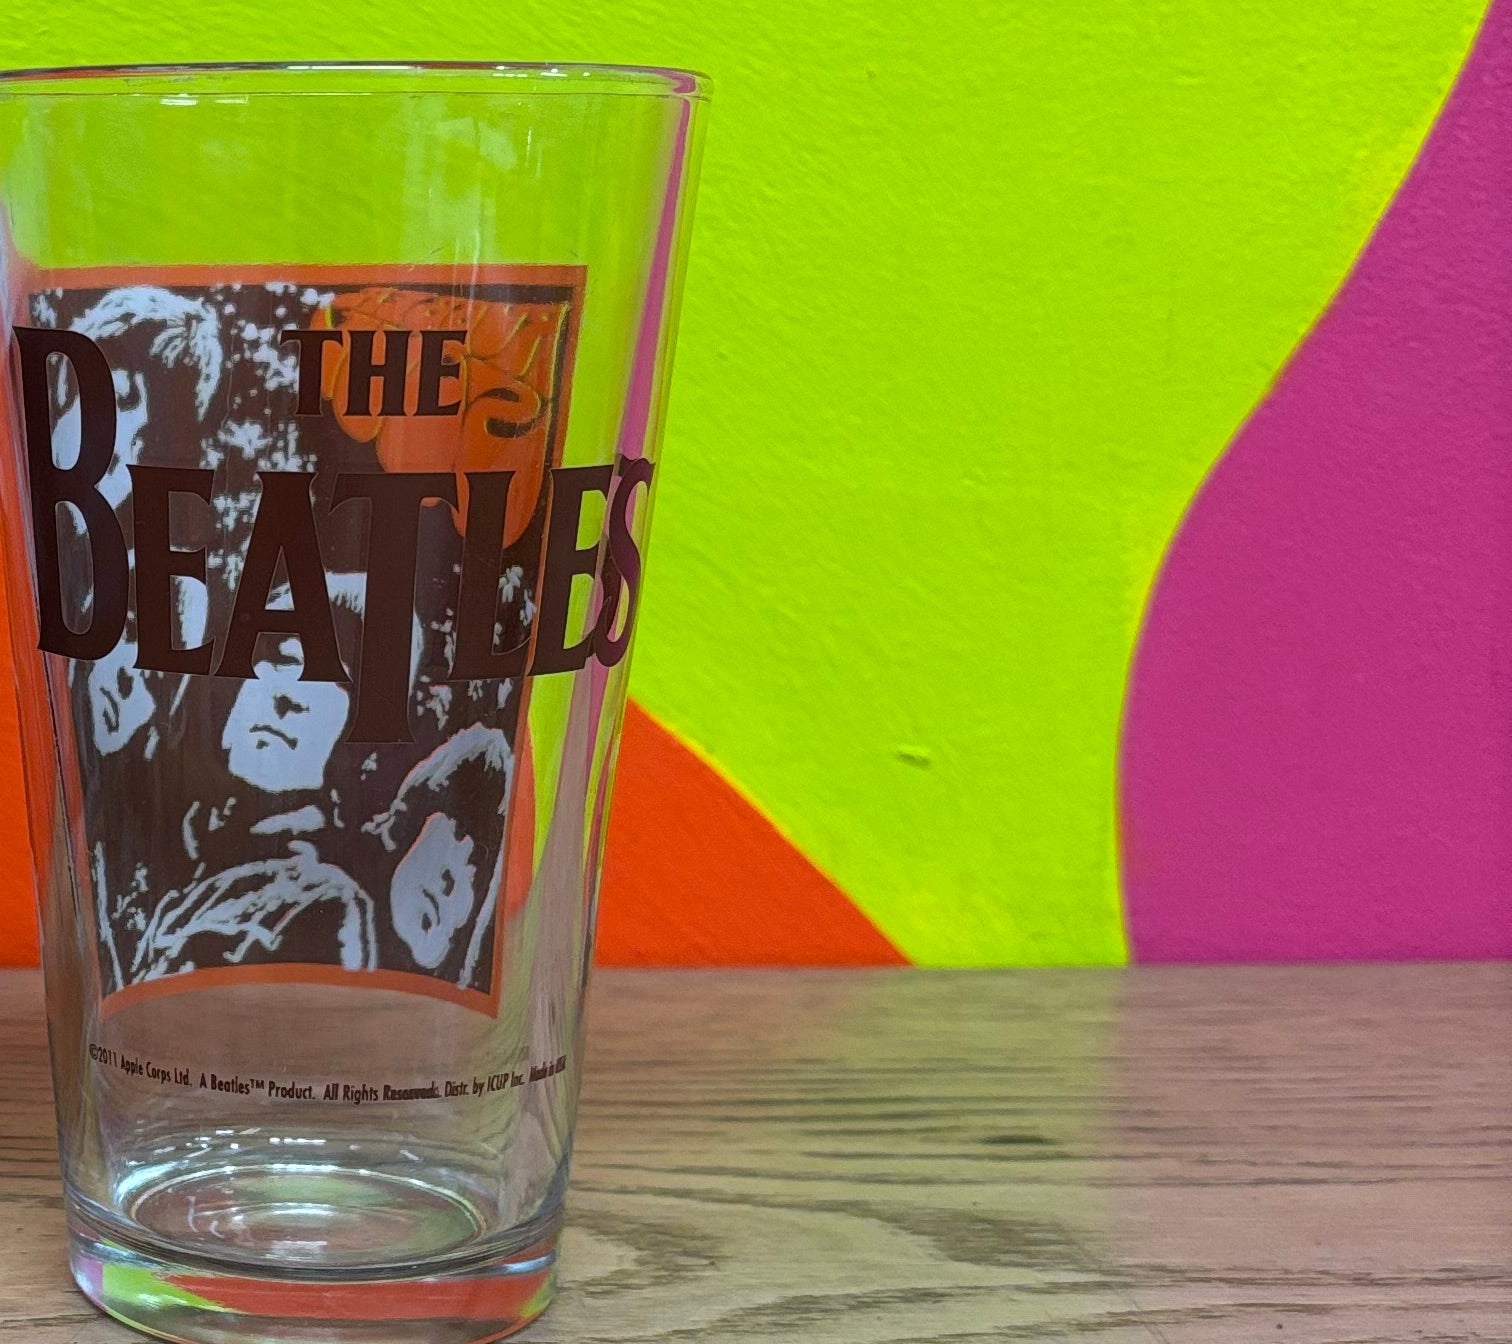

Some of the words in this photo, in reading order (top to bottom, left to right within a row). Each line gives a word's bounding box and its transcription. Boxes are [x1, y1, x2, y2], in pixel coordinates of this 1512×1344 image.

[281, 329, 468, 416] THE
[12, 325, 655, 744] BEATLES
[121, 1054, 143, 1076] Apple
[146, 1060, 171, 1084] Corps
[174, 1067, 192, 1087] Ltd.
[199, 1072, 208, 1088] A
[268, 1080, 316, 1100] Product.
[323, 1082, 338, 1101] All
[343, 1084, 379, 1105] Rights
[472, 1076, 485, 1097] by
[487, 1072, 509, 1093] ICUP
